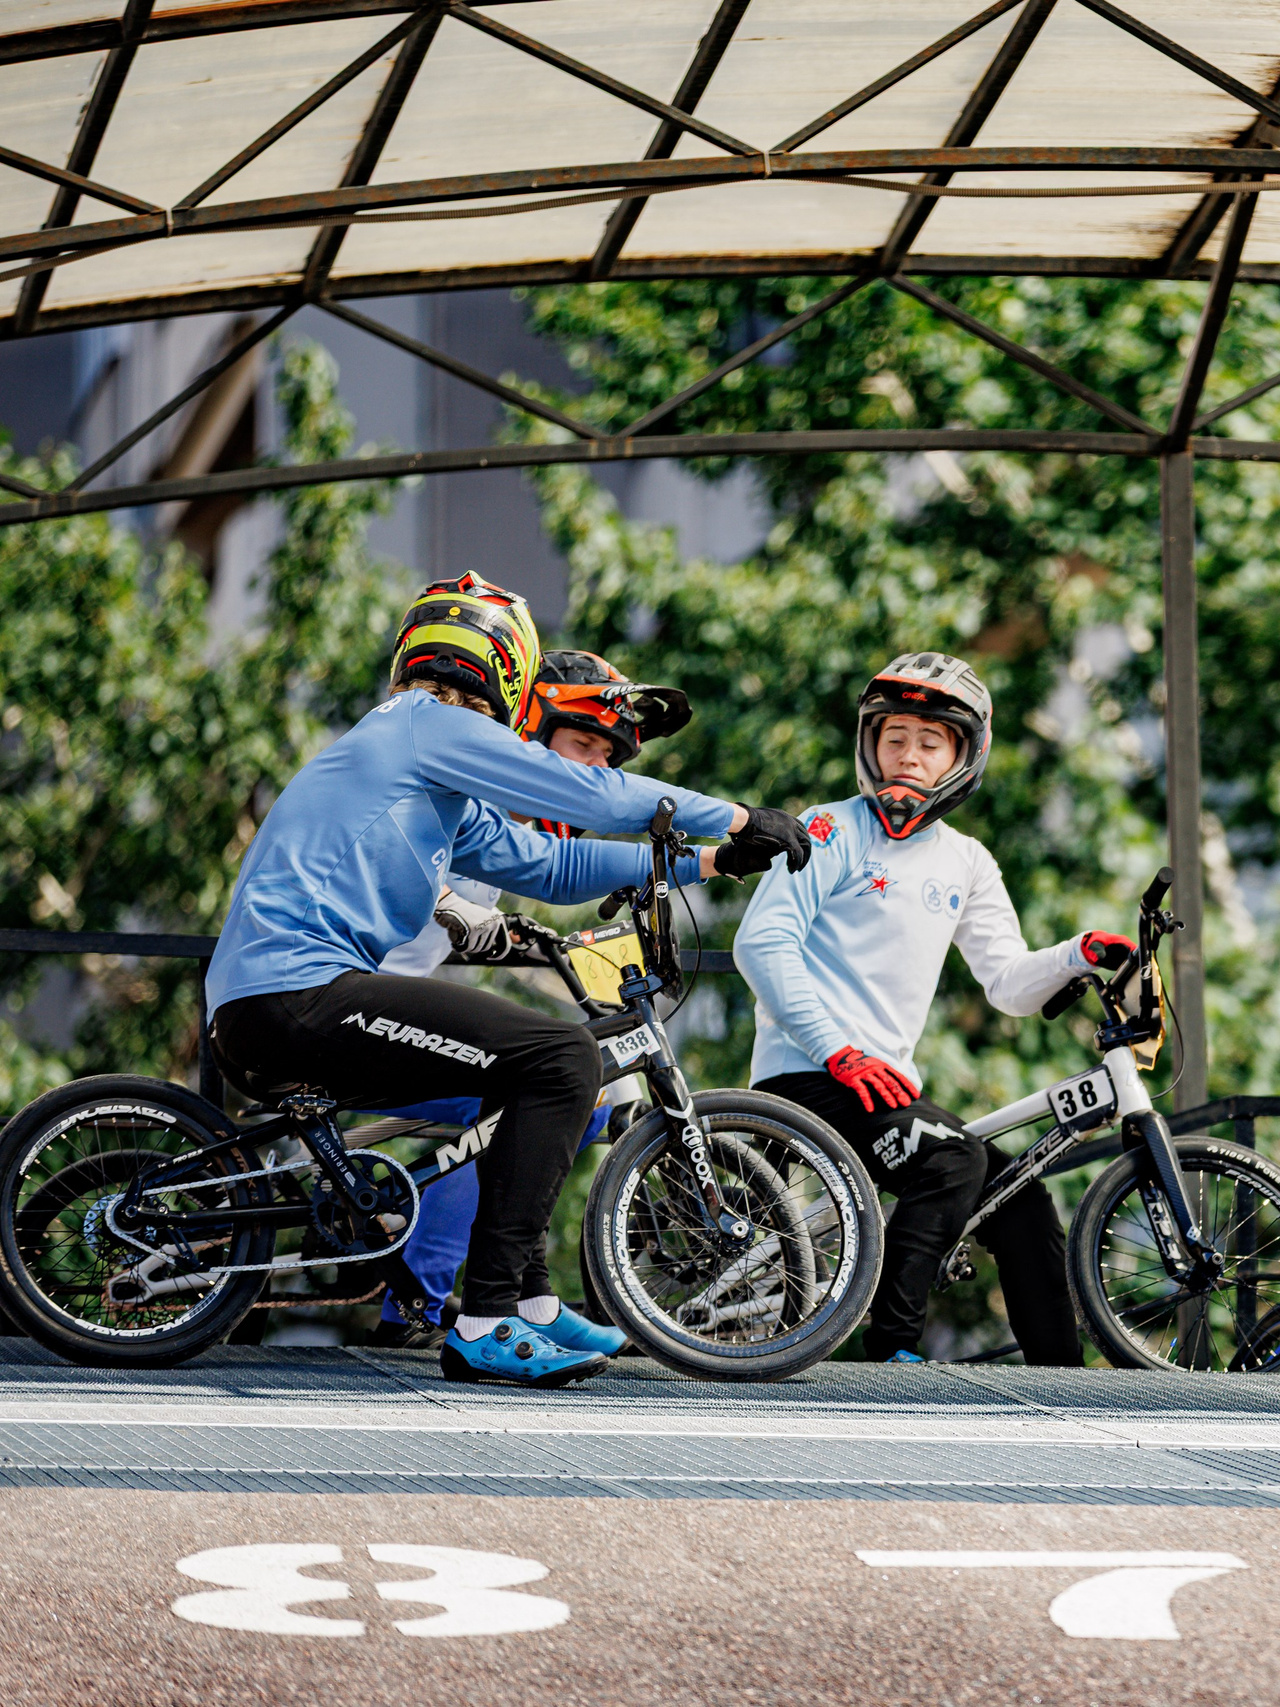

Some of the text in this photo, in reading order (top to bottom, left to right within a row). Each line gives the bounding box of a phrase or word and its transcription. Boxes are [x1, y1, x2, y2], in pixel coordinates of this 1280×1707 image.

[365, 1016, 498, 1069] EVRAZEN
[615, 1022, 650, 1056] 838
[1057, 1079, 1098, 1118] 38
[174, 1543, 571, 1637] 8
[856, 1549, 1249, 1640] 7
